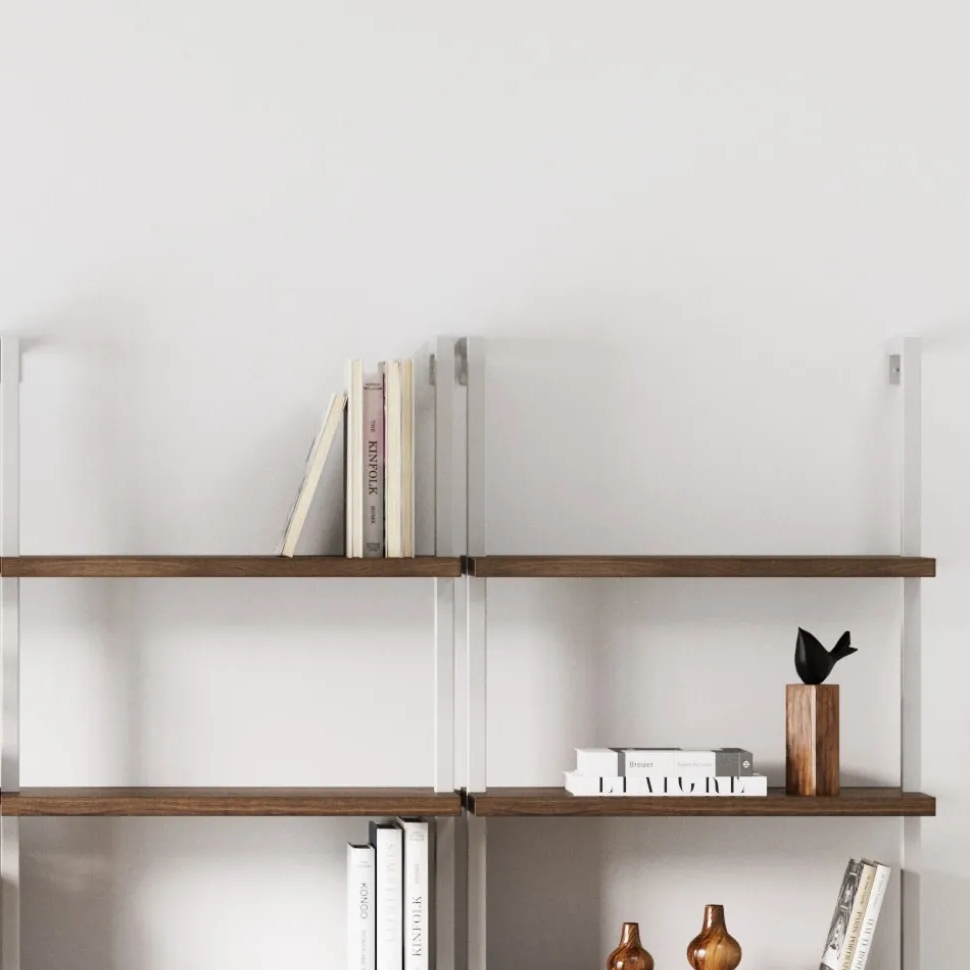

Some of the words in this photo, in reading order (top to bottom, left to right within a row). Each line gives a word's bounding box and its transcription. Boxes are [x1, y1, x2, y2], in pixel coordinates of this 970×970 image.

[368, 440, 378, 495] KINFOLK
[360, 882, 368, 919] KONGO
[412, 896, 422, 957] KINFOLK
